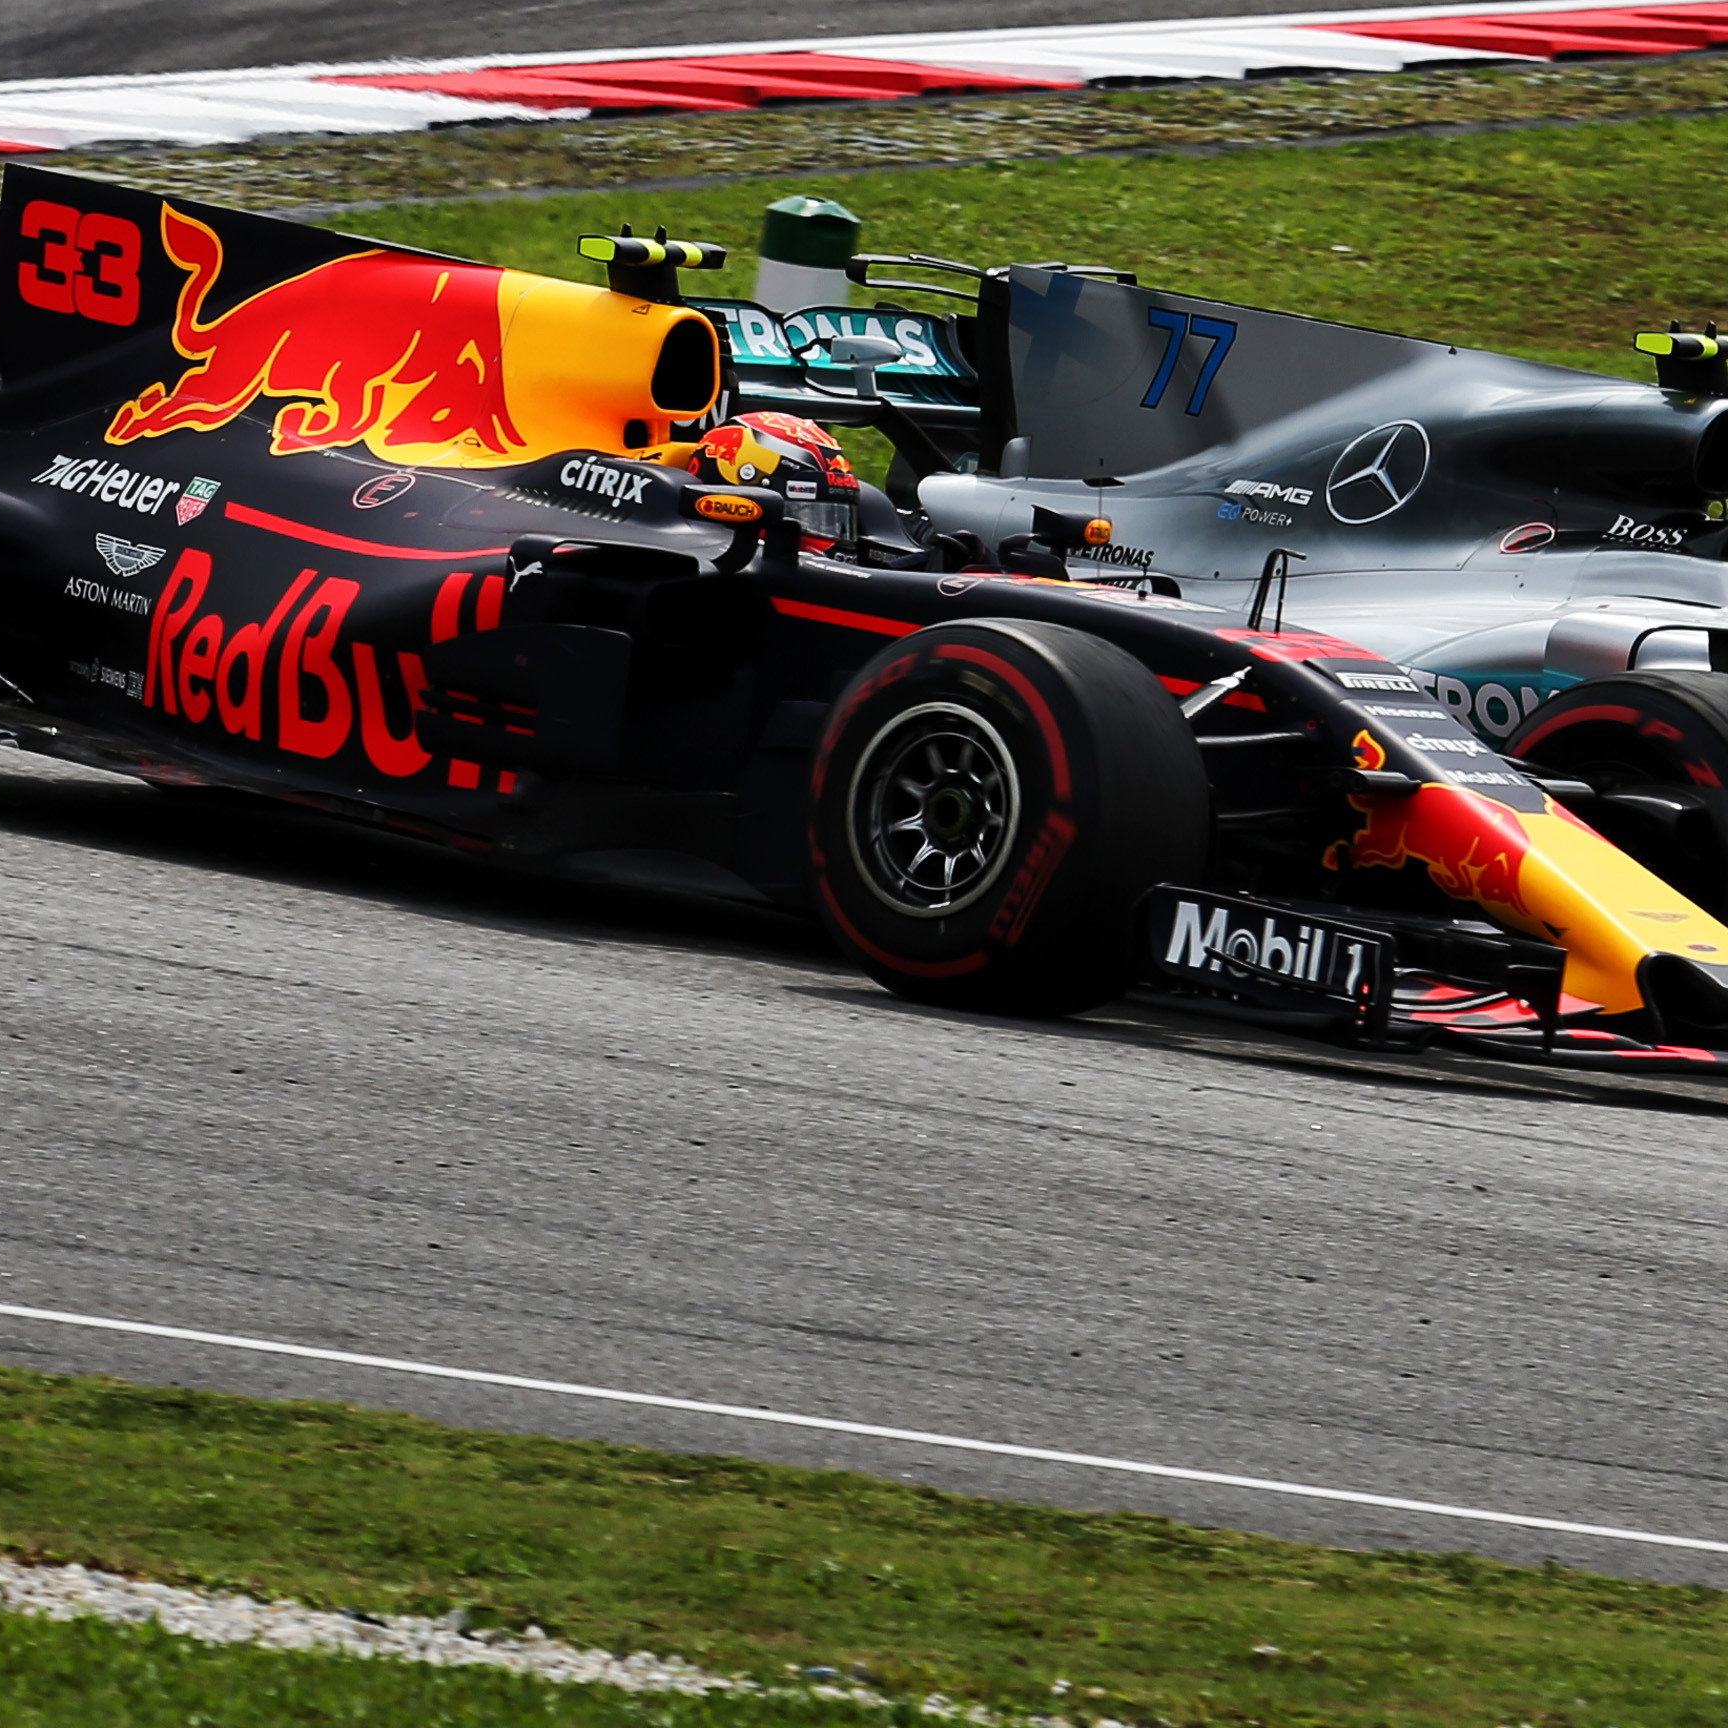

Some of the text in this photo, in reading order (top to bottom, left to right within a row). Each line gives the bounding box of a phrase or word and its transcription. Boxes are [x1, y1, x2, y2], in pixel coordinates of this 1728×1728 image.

[18, 200, 142, 328] 33
[1140, 306, 1239, 417] 77
[1250, 482, 1314, 506] AMG
[713, 502, 755, 516] RAUCH
[1607, 513, 1689, 546] BOSS
[64, 576, 152, 616] ASTON MARTIN
[1335, 672, 1420, 693] PIRELLI
[1363, 705, 1448, 721] Hisense
[1444, 769, 1512, 786] Mobil
[1165, 900, 1325, 983] Mobil
